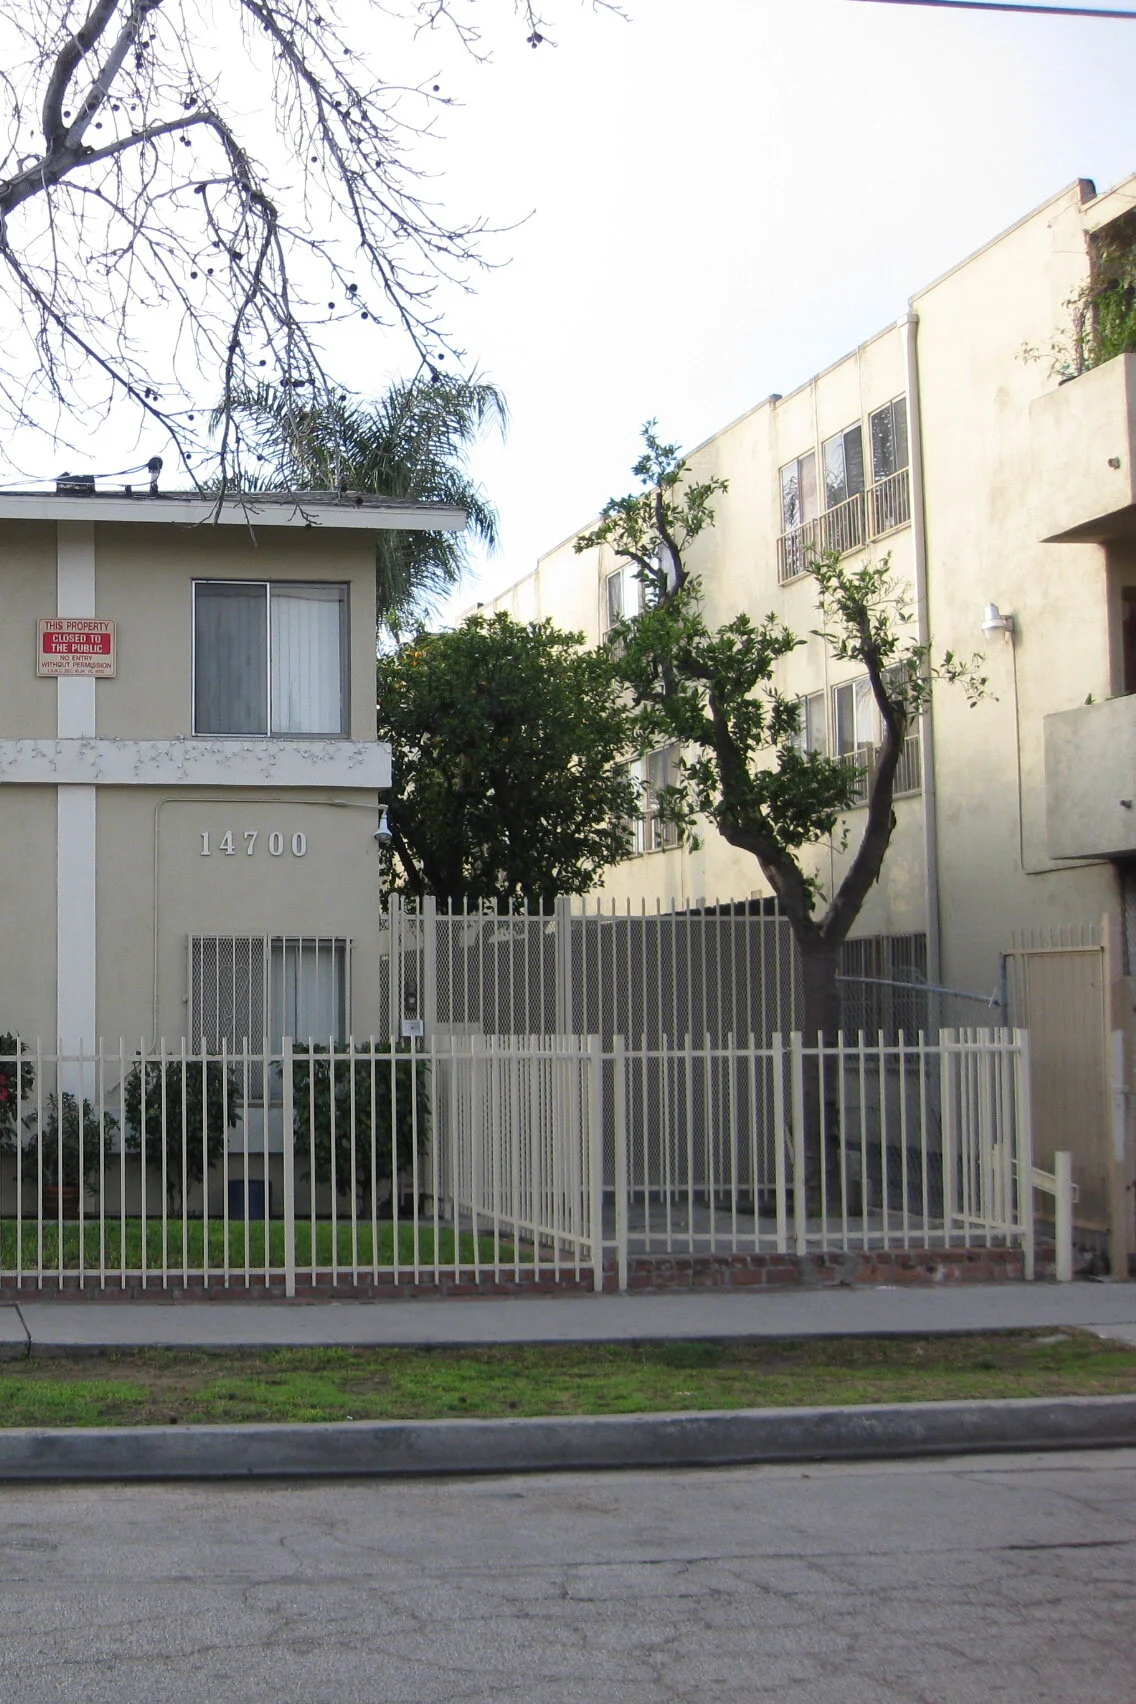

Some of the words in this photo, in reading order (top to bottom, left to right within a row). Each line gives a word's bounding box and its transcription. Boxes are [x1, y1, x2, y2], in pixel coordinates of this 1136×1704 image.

[45, 621, 63, 630] THIS
[66, 621, 110, 631] PROPERTY
[52, 633, 86, 643] CLOSED
[90, 634, 101, 643] TO
[51, 643, 68, 652] THE
[71, 644, 103, 653] PUBLIC
[200, 830, 307, 857] 14700
